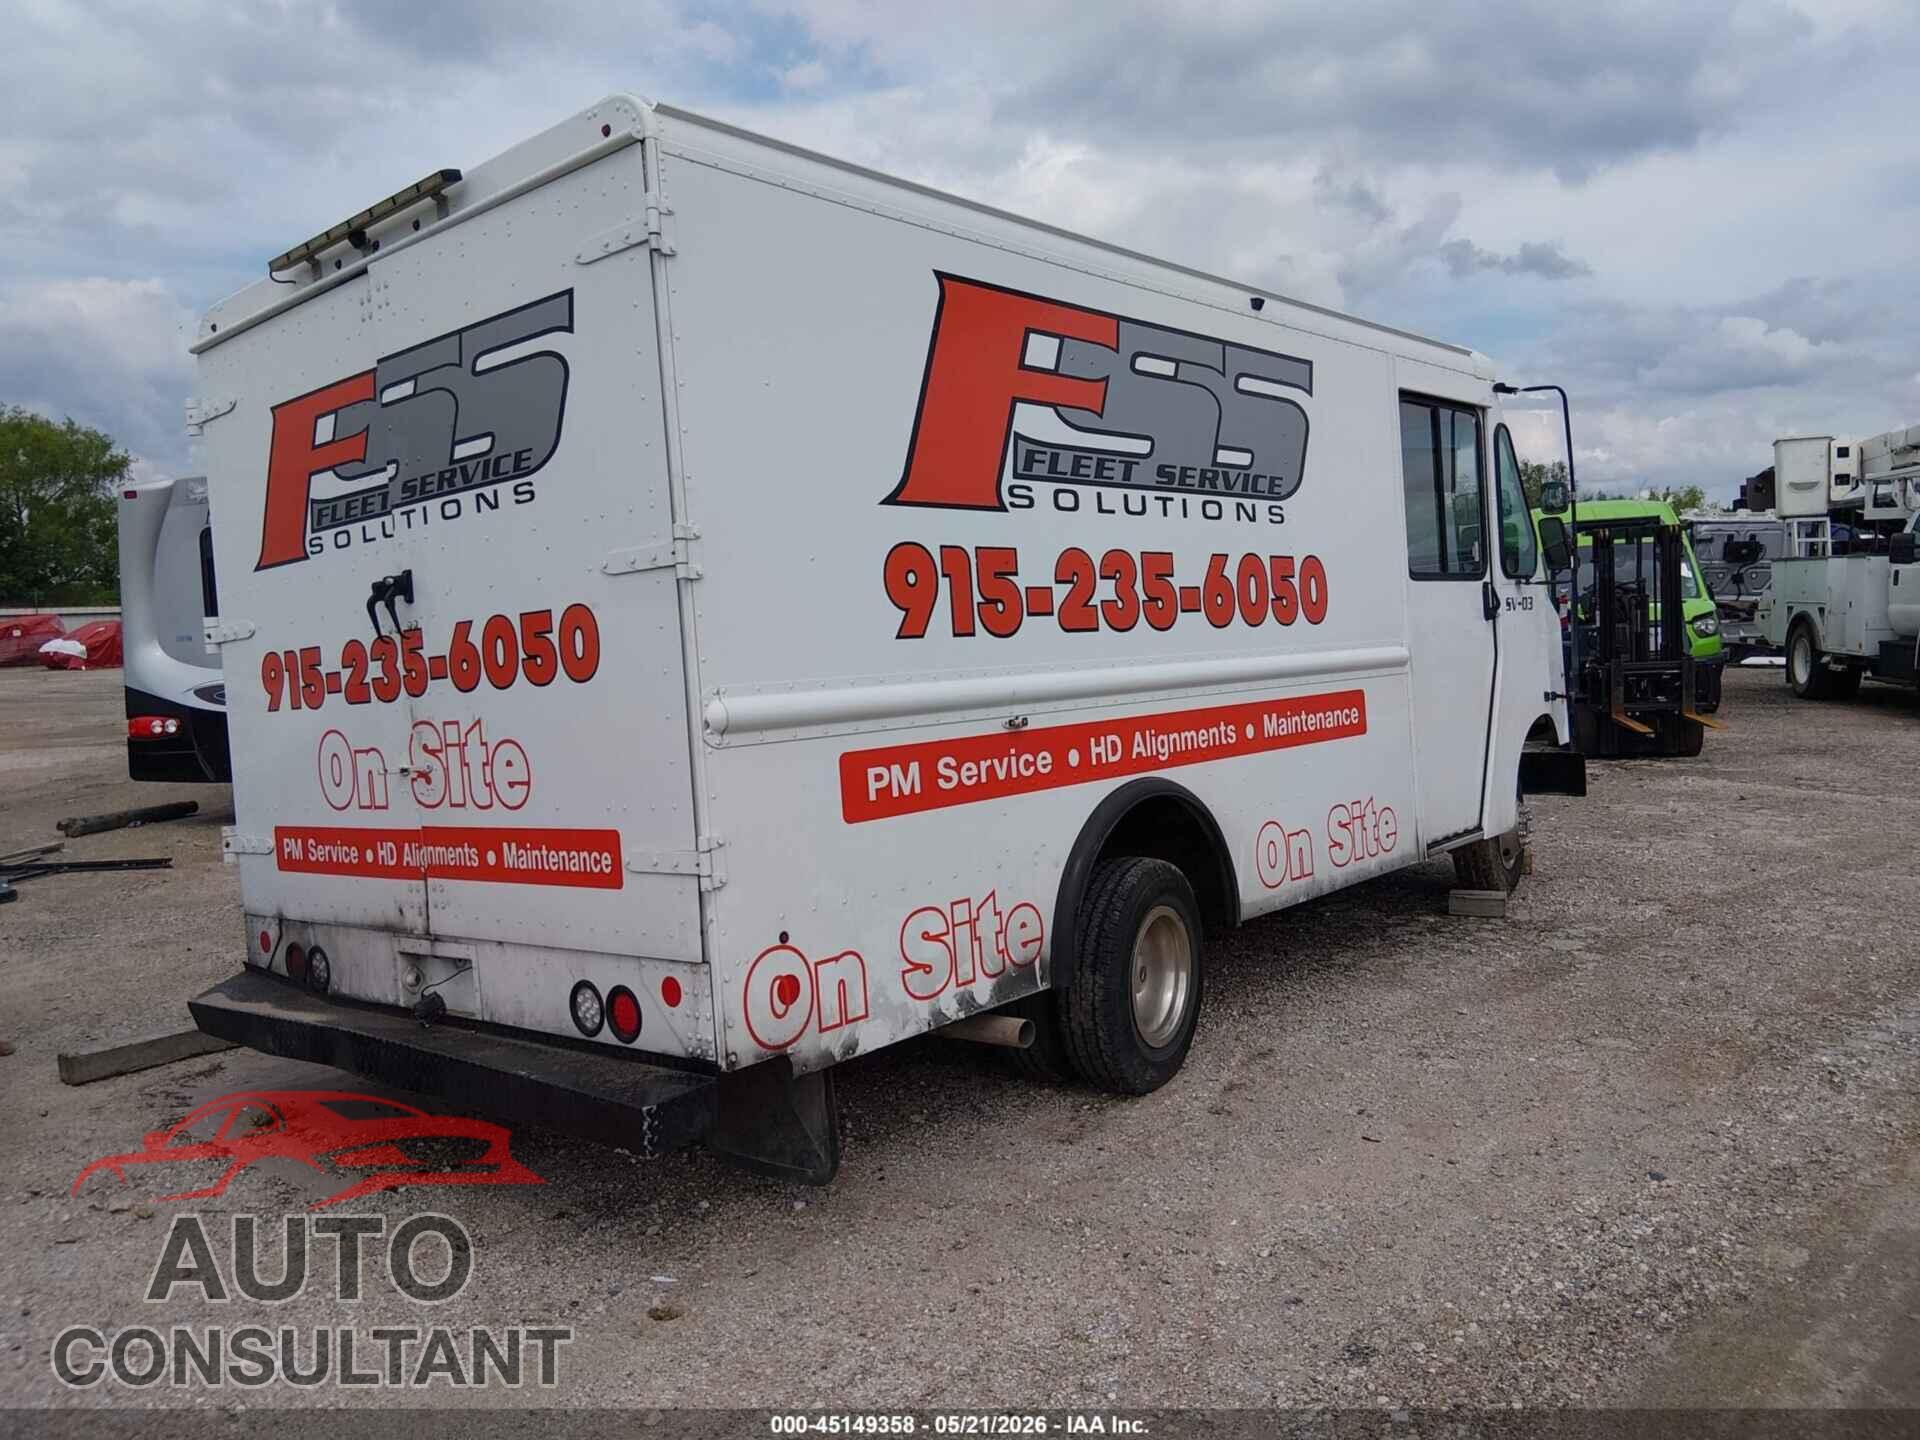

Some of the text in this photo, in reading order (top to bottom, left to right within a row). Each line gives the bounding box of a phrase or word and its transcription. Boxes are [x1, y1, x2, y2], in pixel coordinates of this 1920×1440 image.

[308, 481, 537, 556] SOLUTIONS
[315, 447, 534, 528] FLEET SERVICE
[1007, 484, 1286, 525] SOLUTIONS
[1022, 448, 1284, 496] FLEET SERVICE
[883, 540, 1329, 640] 915-235-6050
[261, 602, 601, 712] 915-235-6050
[318, 718, 532, 811] On Site
[866, 704, 1360, 802] PM Service HD Alignments Maintenance
[282, 836, 613, 874] PM Service HD Alignments Maintenance
[1255, 796, 1398, 890] On Site
[743, 889, 1045, 1051] On Site
